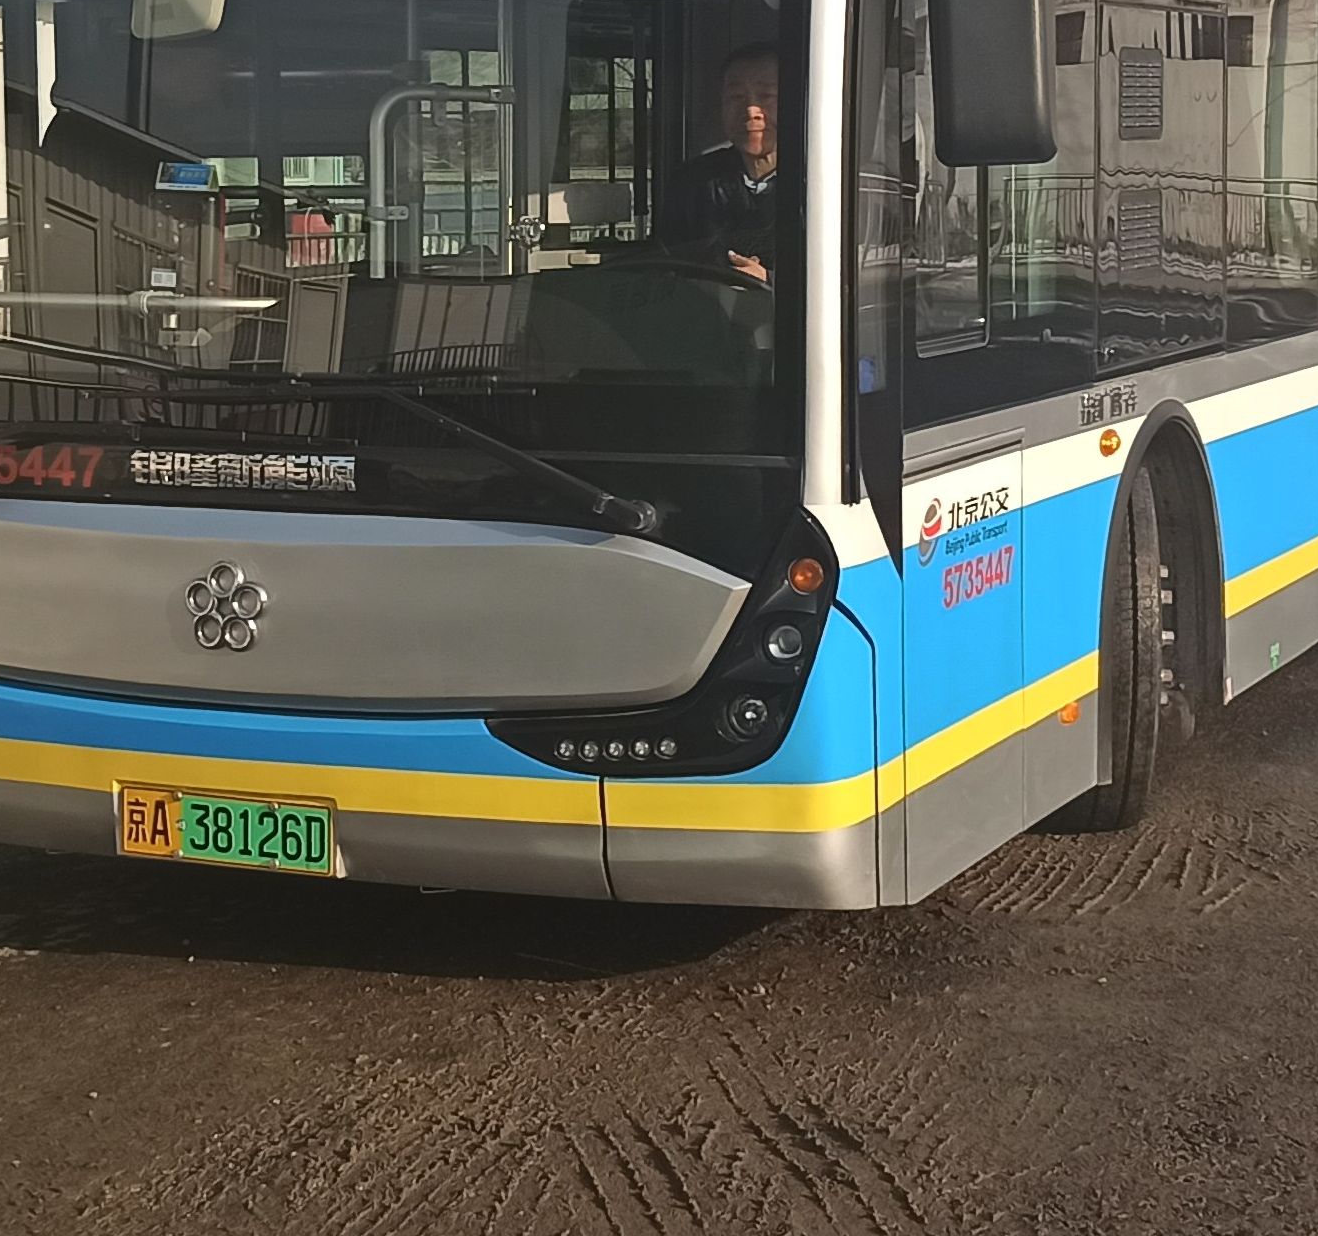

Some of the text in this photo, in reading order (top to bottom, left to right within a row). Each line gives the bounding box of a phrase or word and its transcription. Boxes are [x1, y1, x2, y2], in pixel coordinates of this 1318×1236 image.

[130, 449, 357, 492] 银隆新能源
[947, 486, 1009, 533] 北京公交
[945, 537, 965, 556] Beijing
[981, 520, 1008, 540] Transport
[943, 546, 1014, 609] 5735447
[127, 798, 326, 863] 京A 38126D
